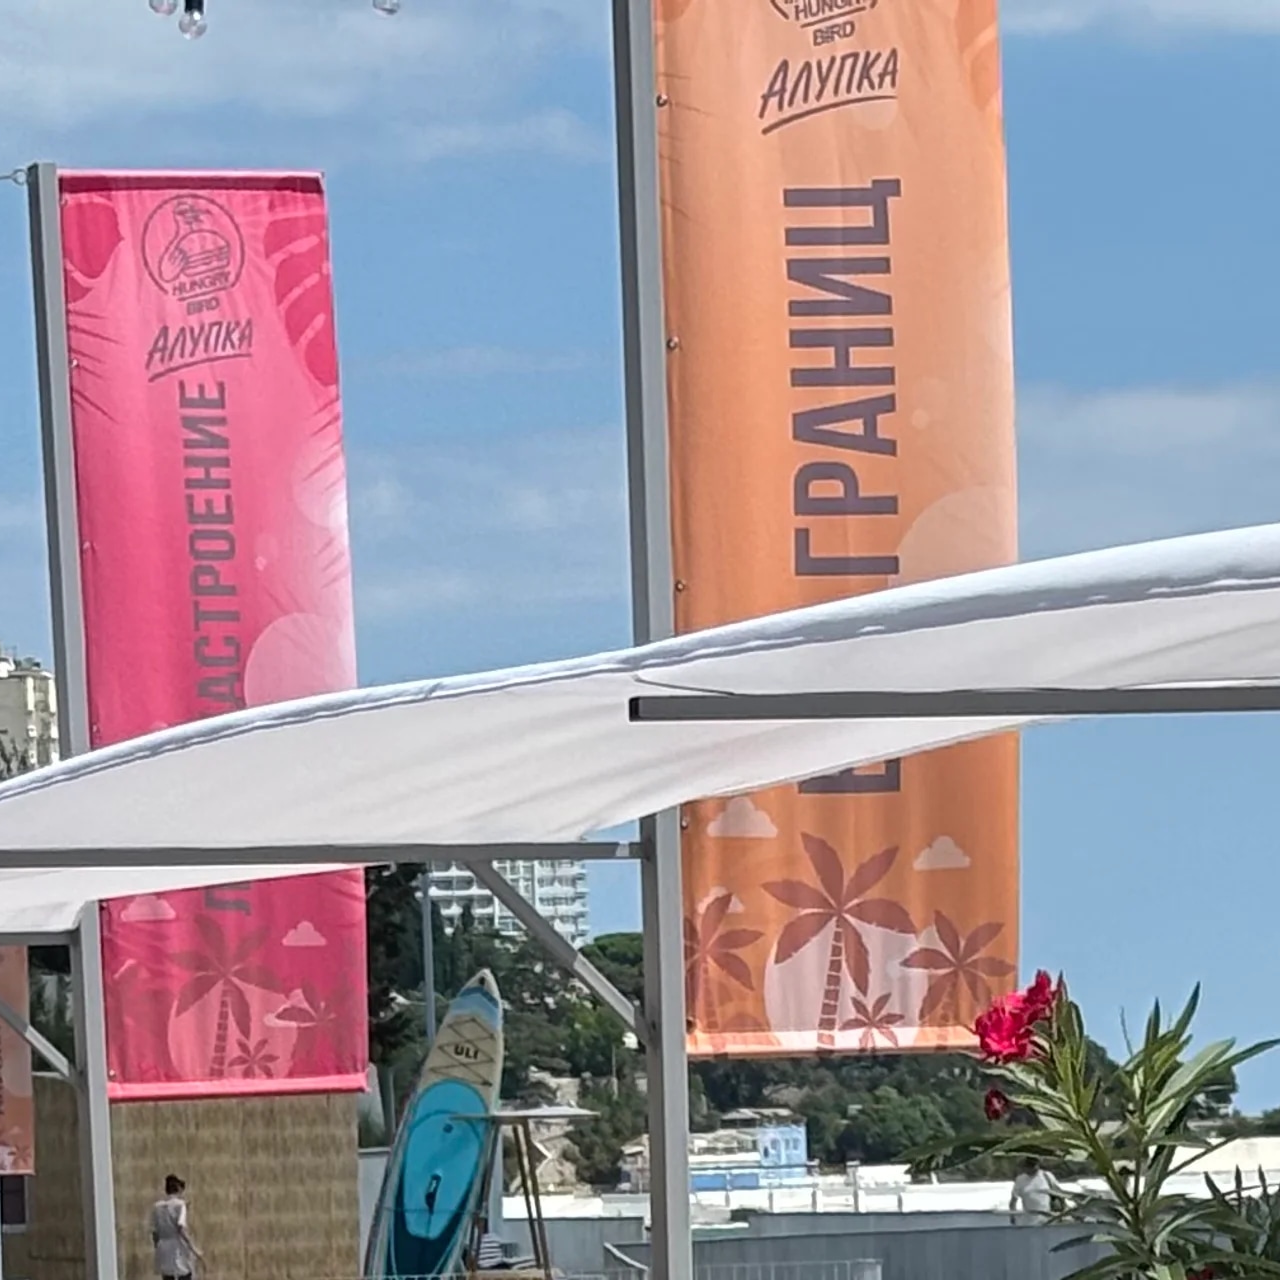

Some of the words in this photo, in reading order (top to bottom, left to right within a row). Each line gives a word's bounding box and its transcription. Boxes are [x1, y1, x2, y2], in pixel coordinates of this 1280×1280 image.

[813, 21, 856, 46] BIRD
[758, 47, 899, 119] АЛУПКА
[172, 271, 231, 296] HUNGRY
[144, 317, 254, 371] АЛУПКА
[782, 177, 901, 578] ГРАНИЦ
[178, 379, 247, 718] АСТРОЕНИЕ
[454, 1043, 479, 1060] ULI
